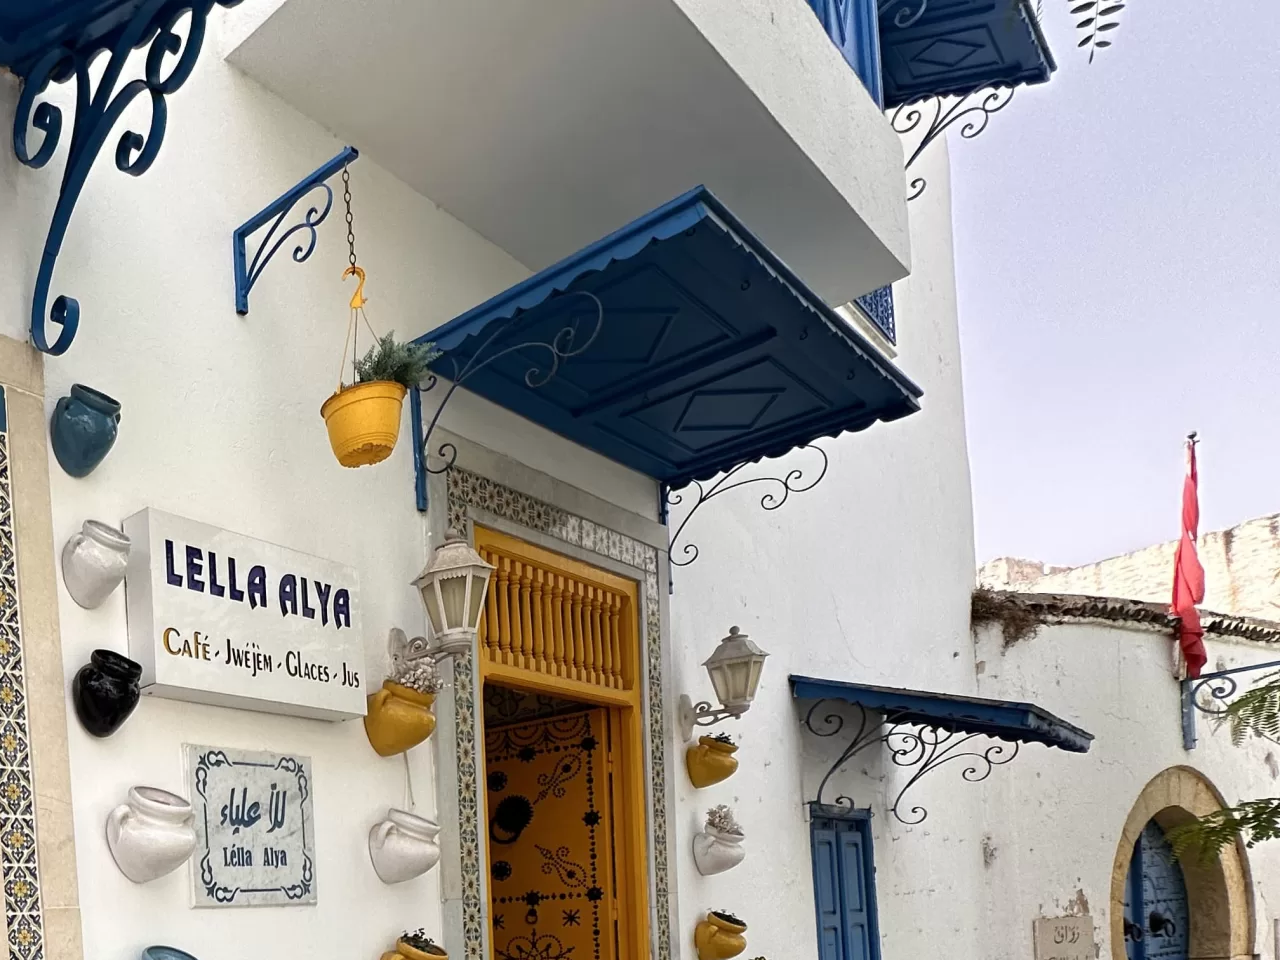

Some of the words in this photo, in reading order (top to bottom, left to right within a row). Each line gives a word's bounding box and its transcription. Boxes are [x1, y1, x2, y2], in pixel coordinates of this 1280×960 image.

[165, 539, 267, 610] LELLA
[279, 573, 351, 630] ALYA
[223, 843, 253, 867] Lélla
[263, 847, 288, 869] Alya
